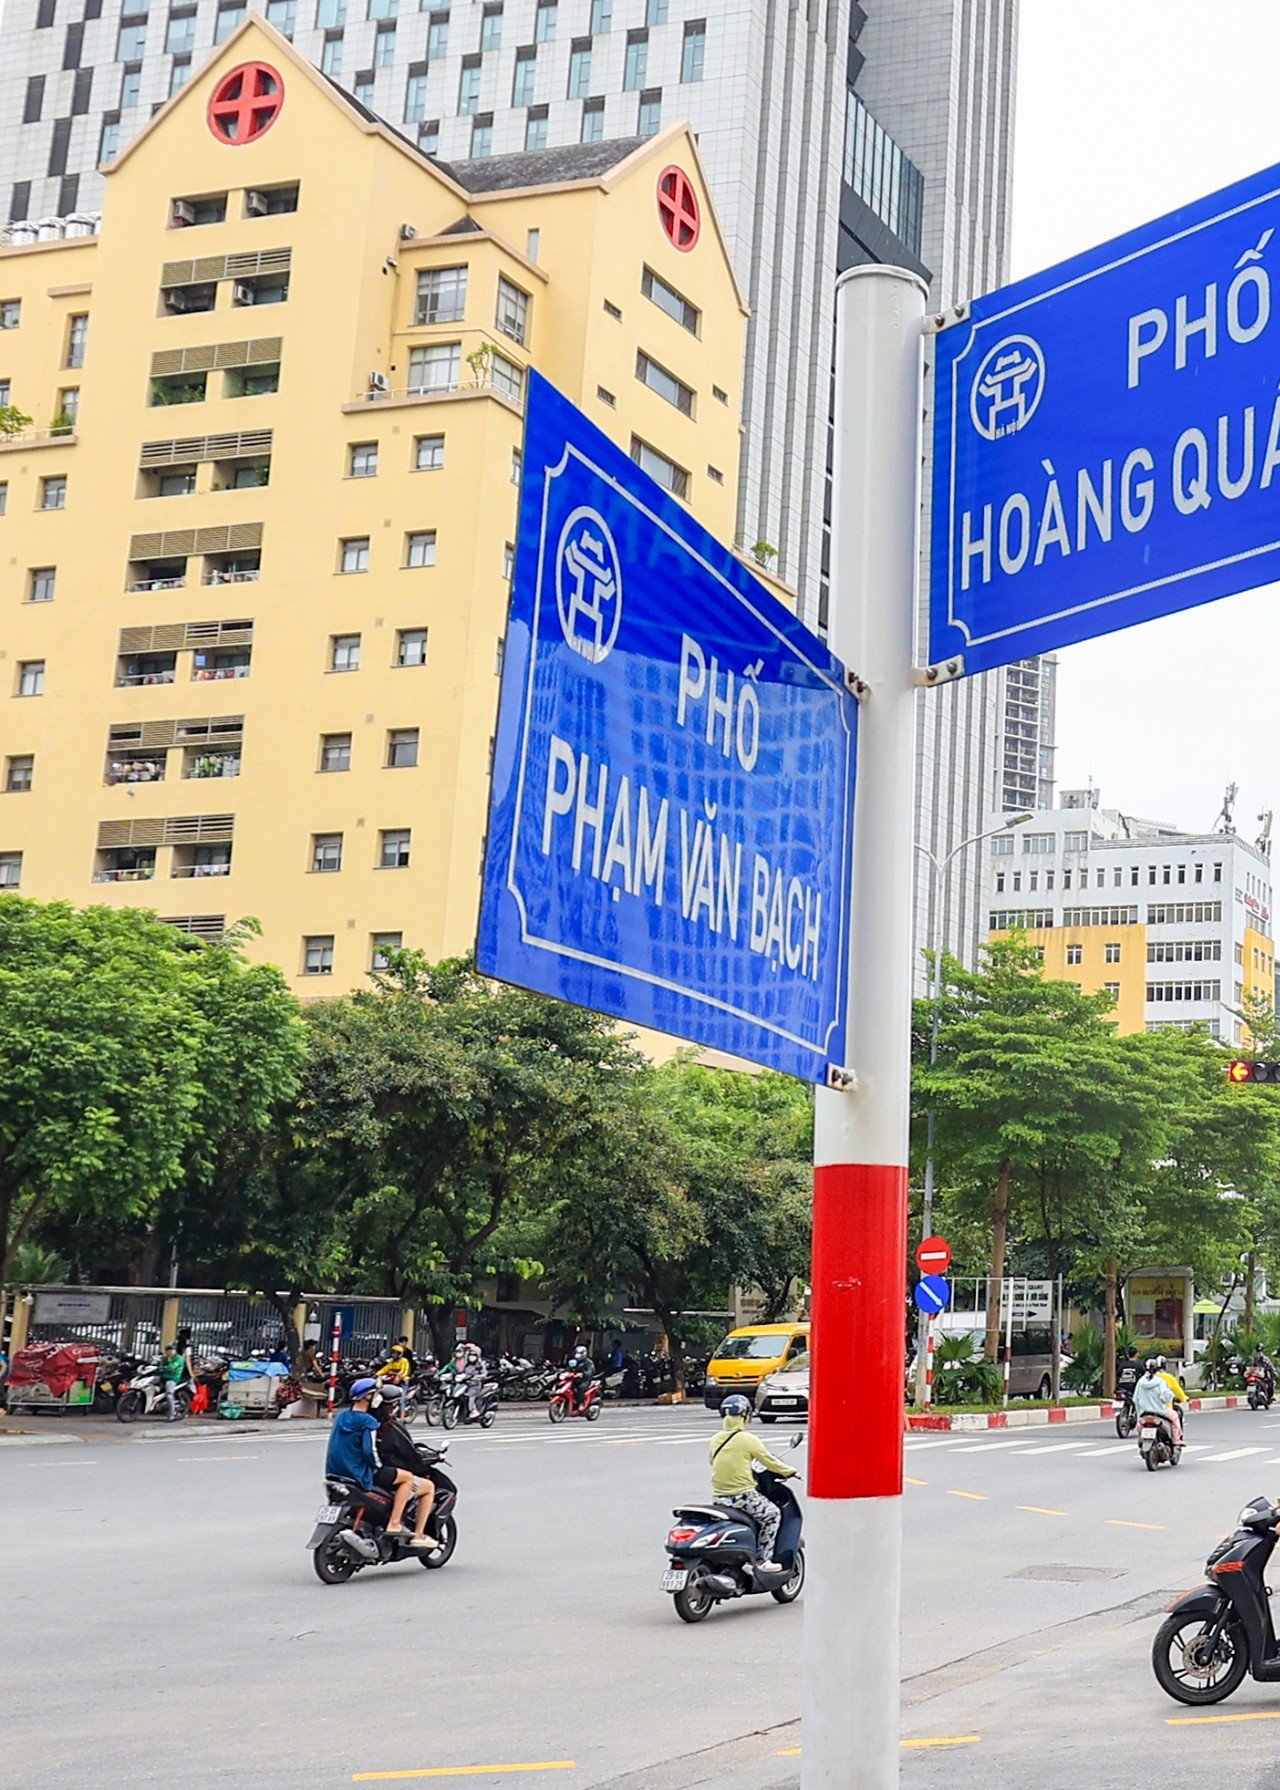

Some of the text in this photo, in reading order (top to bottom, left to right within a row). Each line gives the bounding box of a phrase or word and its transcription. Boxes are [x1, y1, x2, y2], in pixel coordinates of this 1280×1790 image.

[1128, 227, 1275, 389] PHỐ
[961, 448, 1155, 590] HOÀNG
[676, 633, 764, 772] PHỐ
[541, 734, 823, 982] PHẠM VĂN BẠCH
